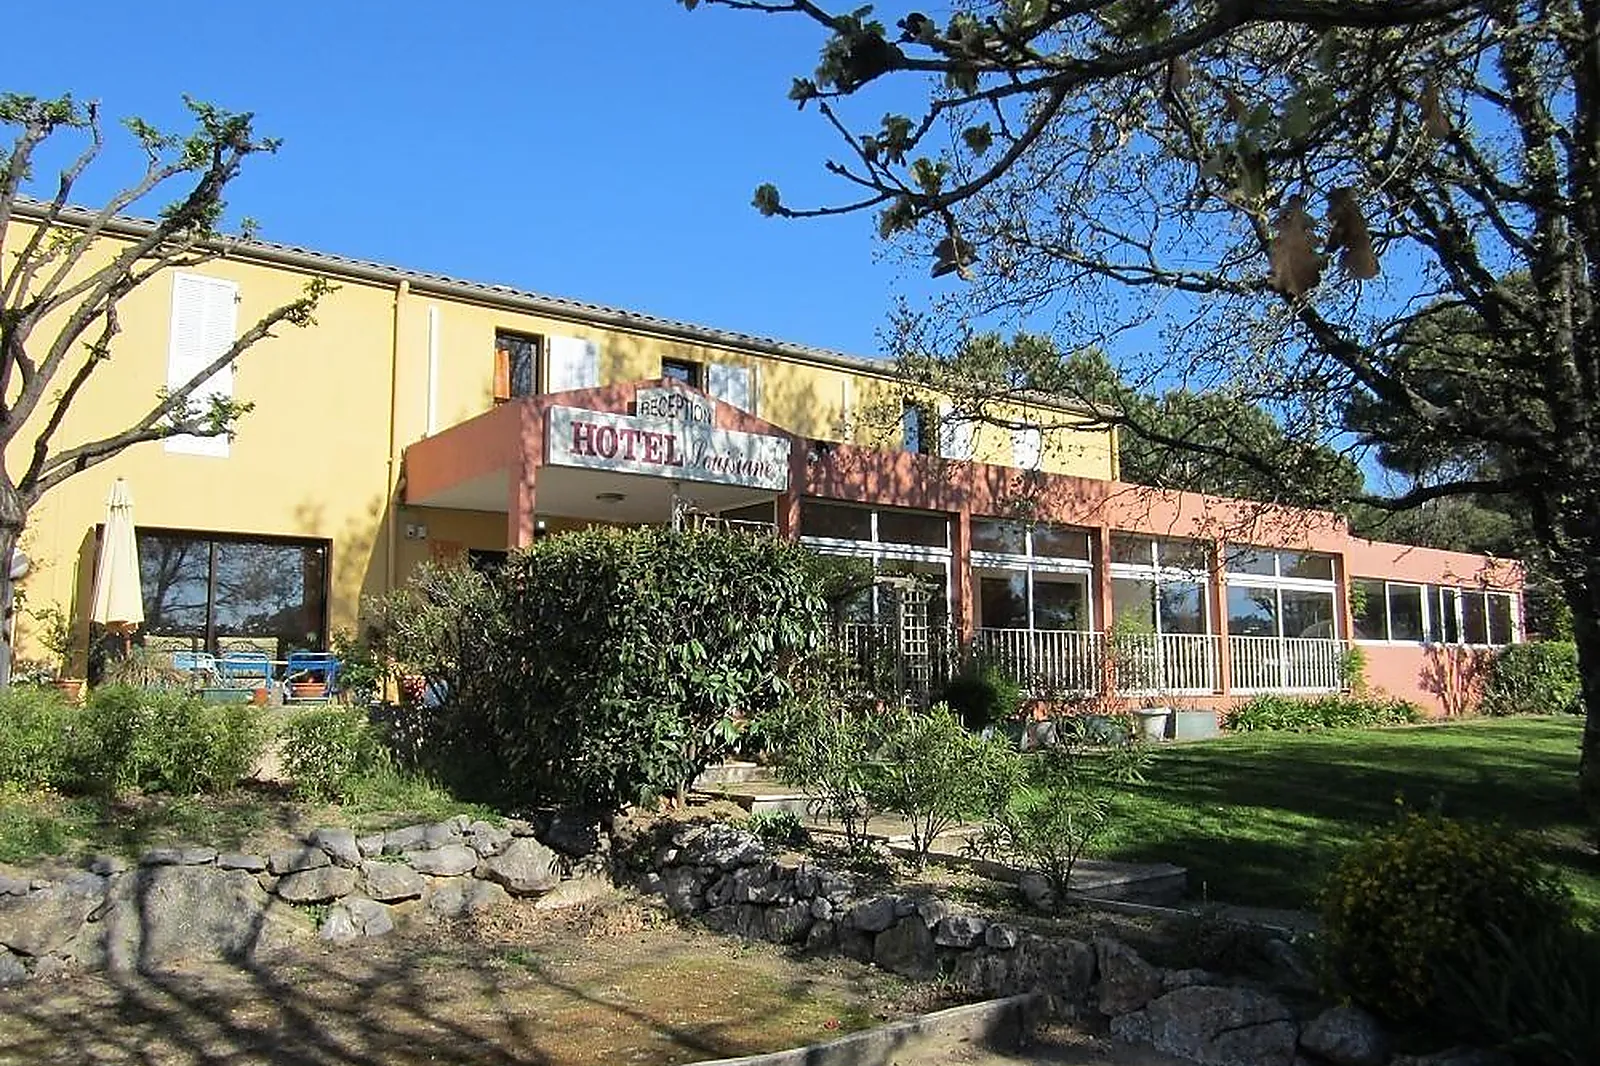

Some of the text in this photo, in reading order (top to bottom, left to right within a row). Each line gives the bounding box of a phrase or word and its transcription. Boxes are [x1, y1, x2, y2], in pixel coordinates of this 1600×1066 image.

[640, 393, 712, 424] RECEPTION
[569, 421, 777, 479] HOTEL Louisiane
